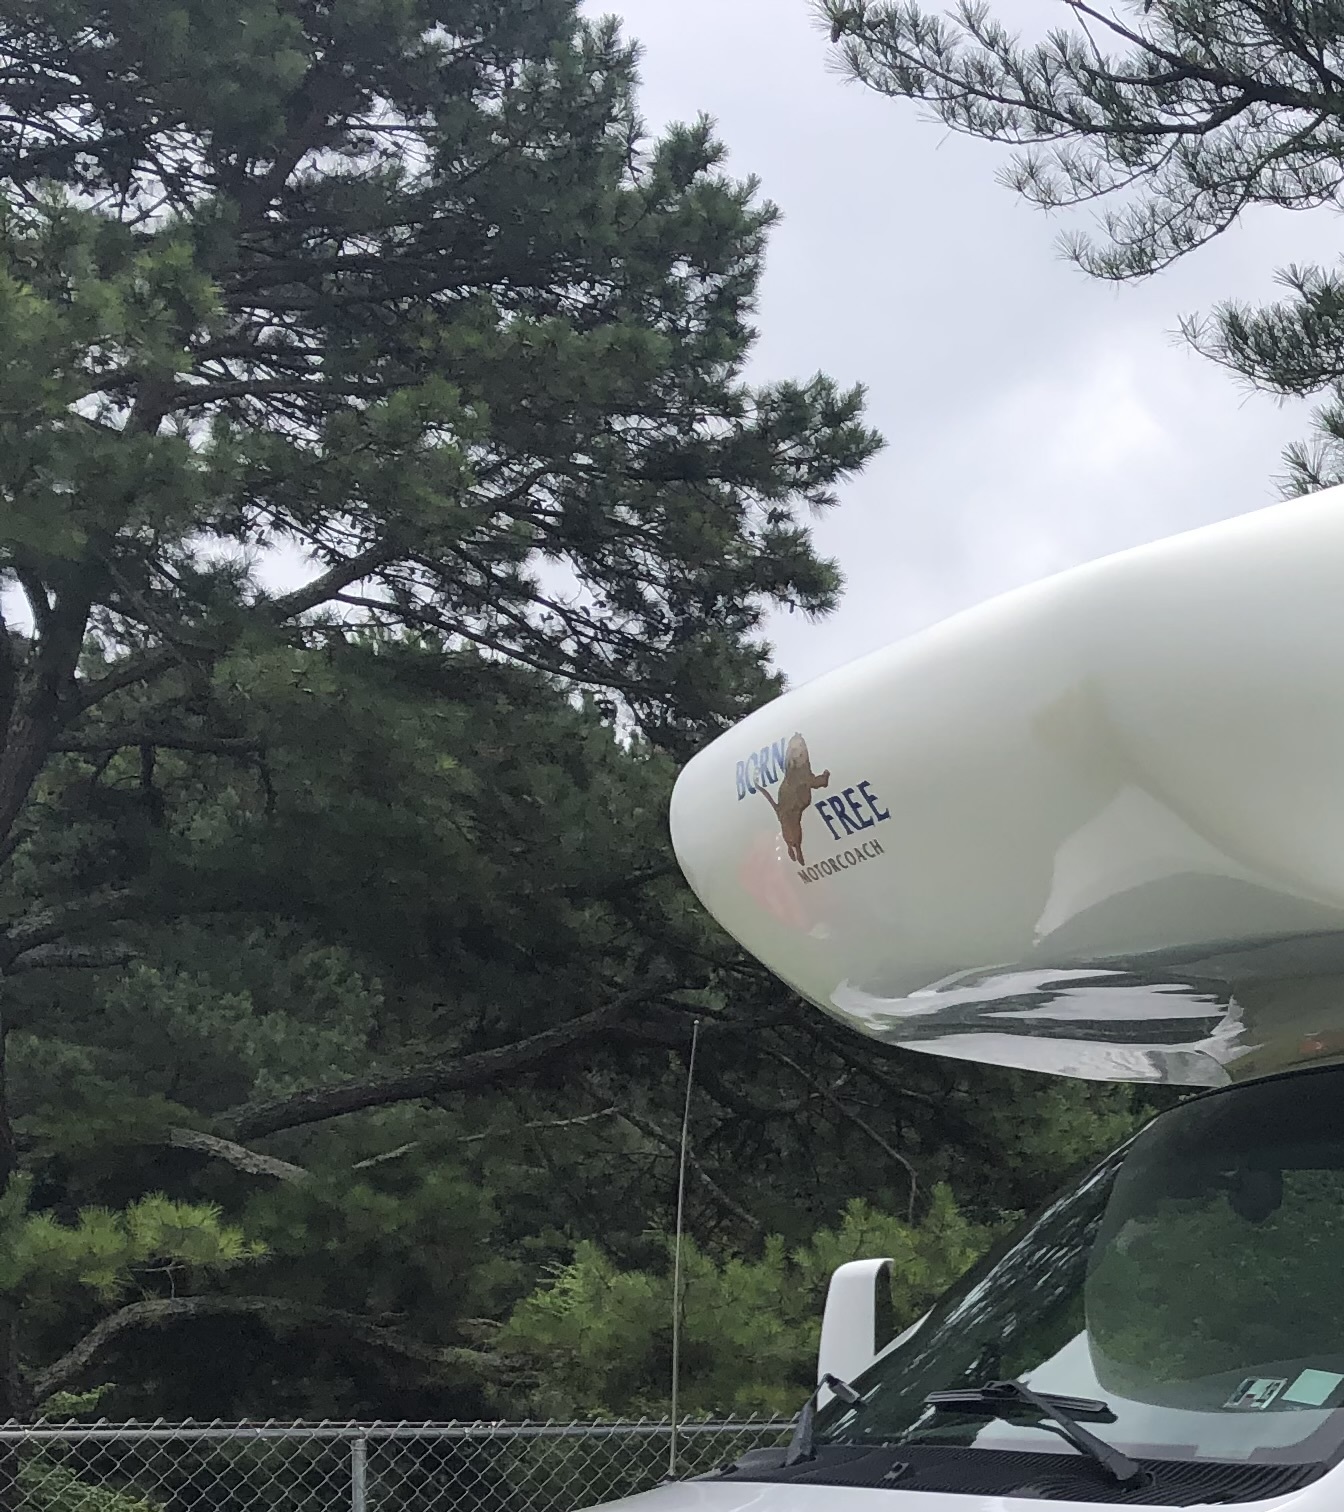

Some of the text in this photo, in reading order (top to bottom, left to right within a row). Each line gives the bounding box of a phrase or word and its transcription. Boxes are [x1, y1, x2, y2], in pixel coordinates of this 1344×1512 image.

[736, 738, 787, 801] BORN
[815, 780, 891, 840] FREE
[798, 839, 885, 884] MOTORCOACH
